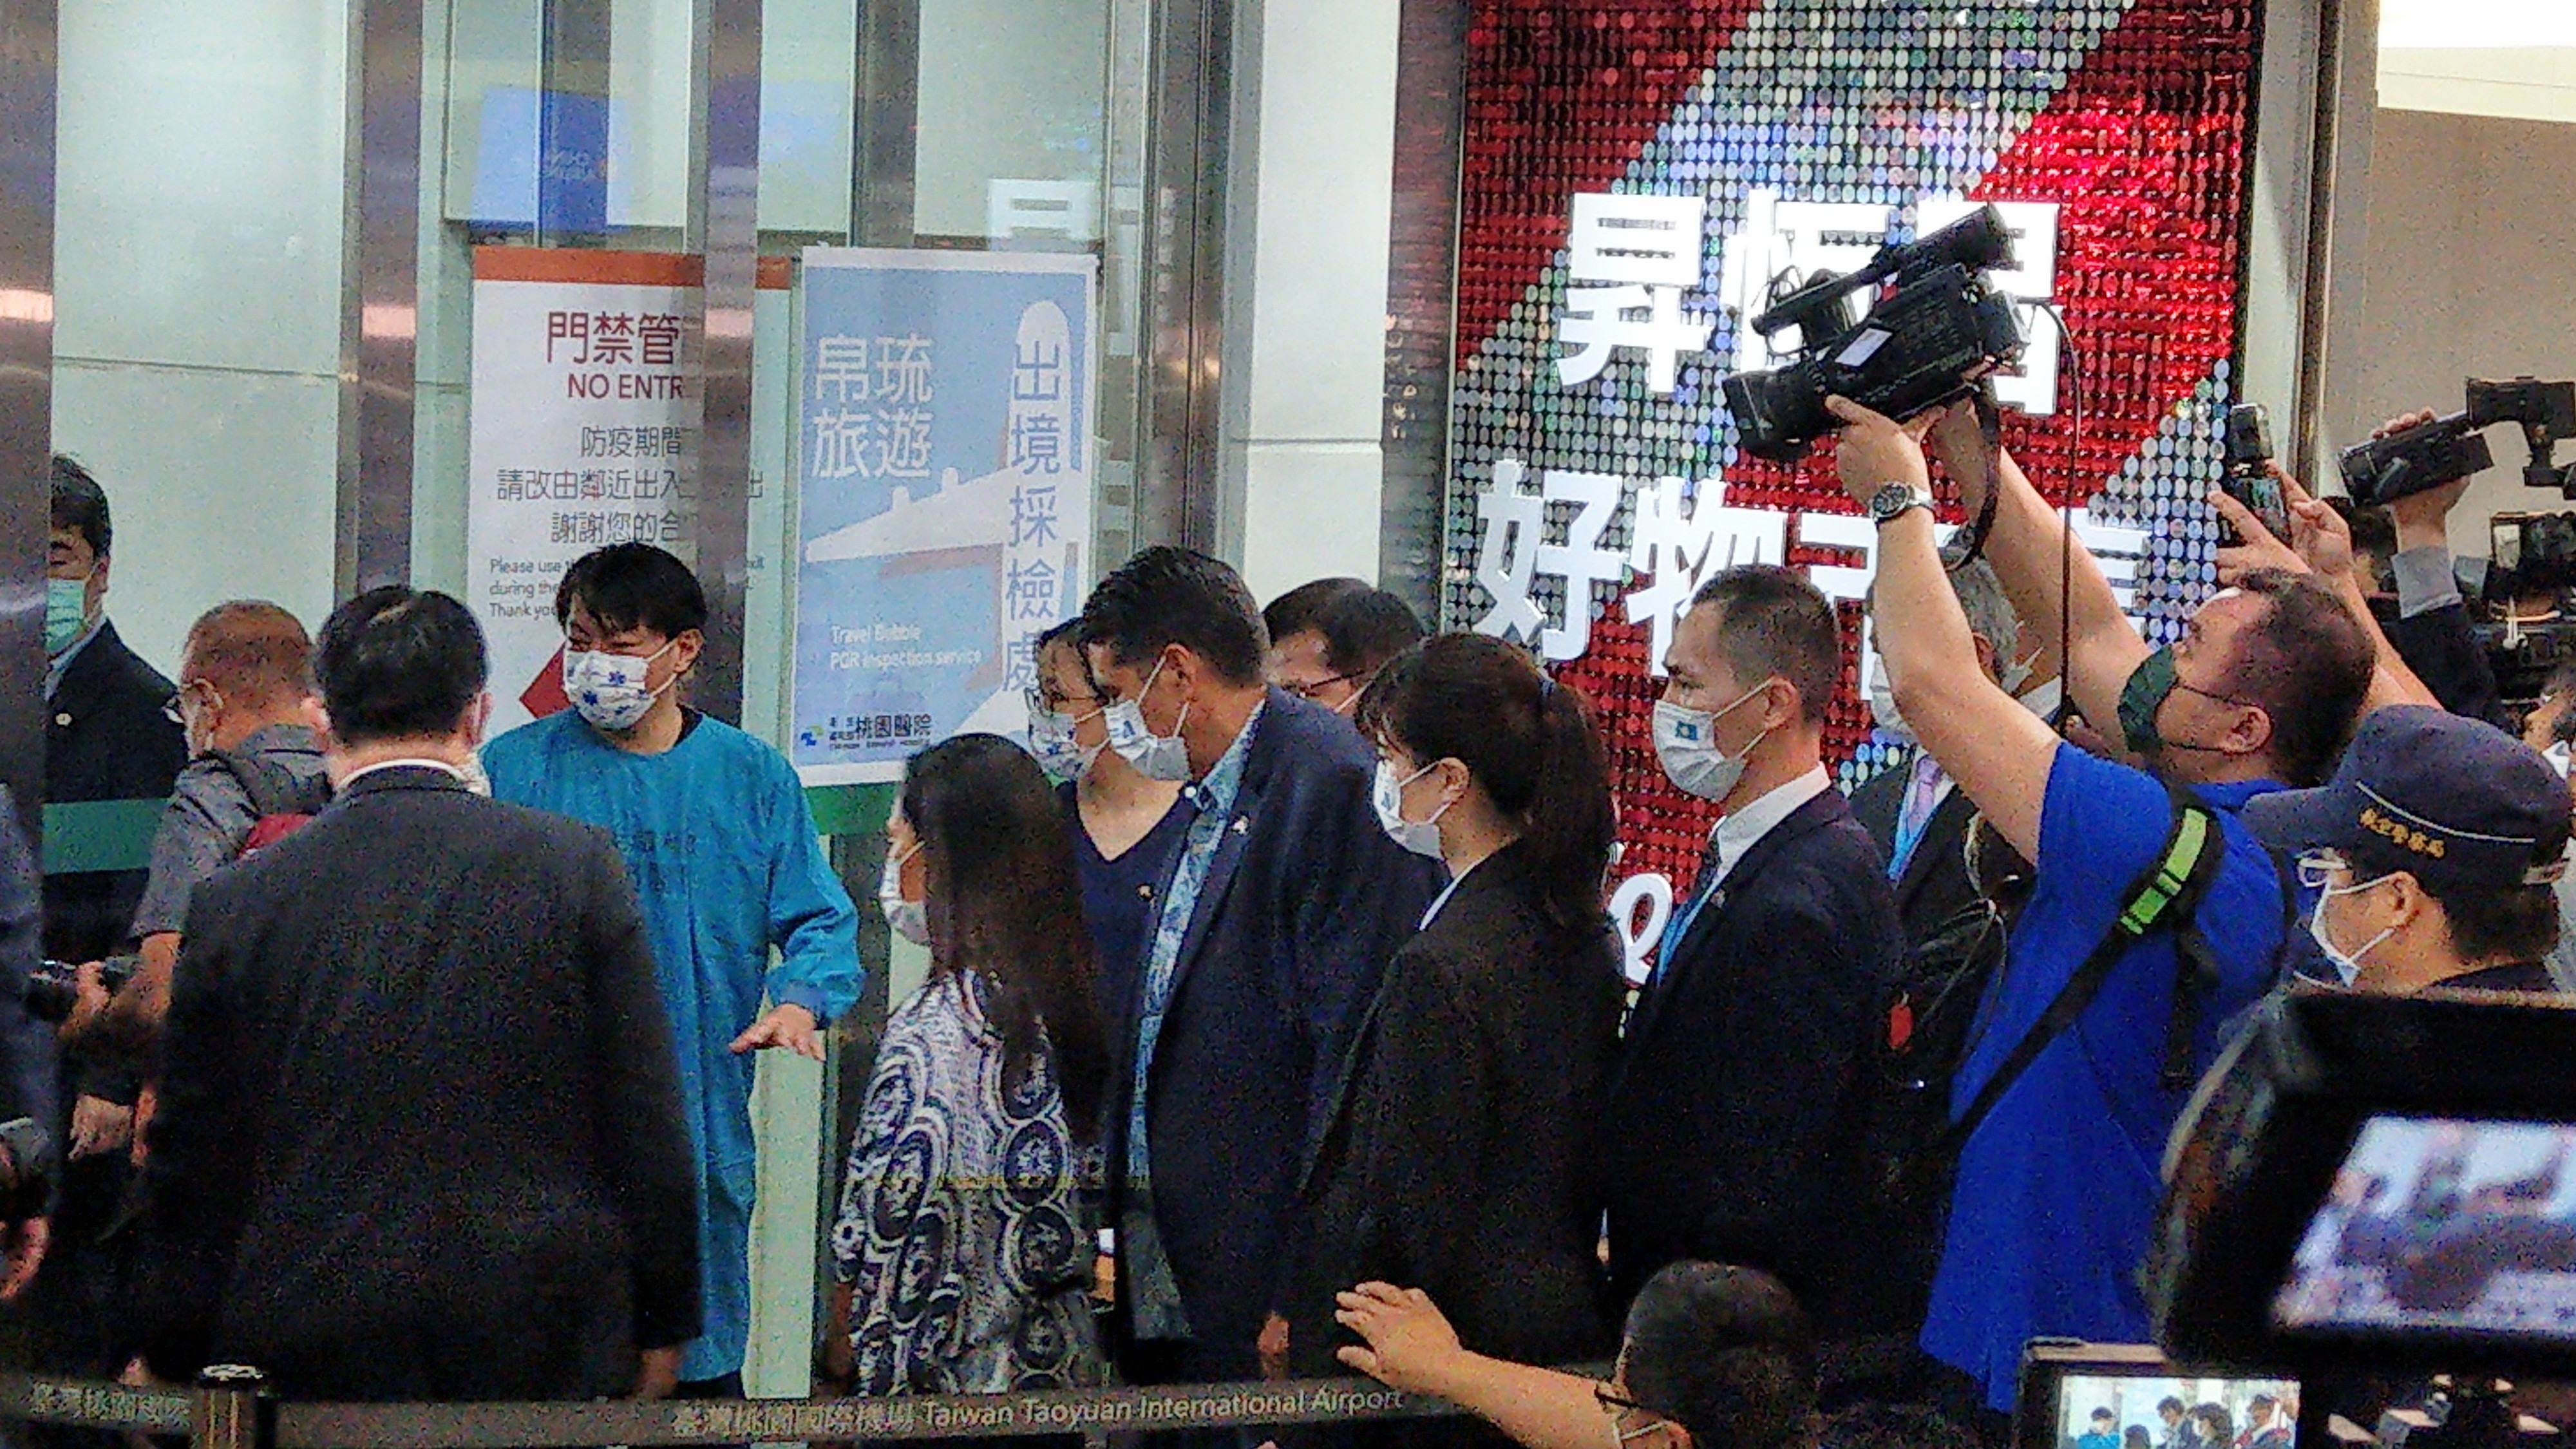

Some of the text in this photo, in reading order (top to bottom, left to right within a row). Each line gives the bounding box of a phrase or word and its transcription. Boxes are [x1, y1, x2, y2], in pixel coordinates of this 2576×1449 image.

[815, 333, 934, 403] 帛琉
[567, 373, 610, 399] NO
[581, 426, 681, 458] 防疫期間
[811, 407, 934, 478] 旅遊
[490, 556, 534, 574] Please
[538, 560, 562, 573] use
[489, 580, 535, 598] during
[489, 601, 532, 618] Thank
[830, 625, 871, 643] Travel
[830, 651, 860, 670] PCR
[922, 1400, 1014, 1426] Taiwan
[1021, 1397, 1132, 1432] Taoyuan
[1141, 1388, 1304, 1419] International
[1312, 1385, 1404, 1415] Airport
